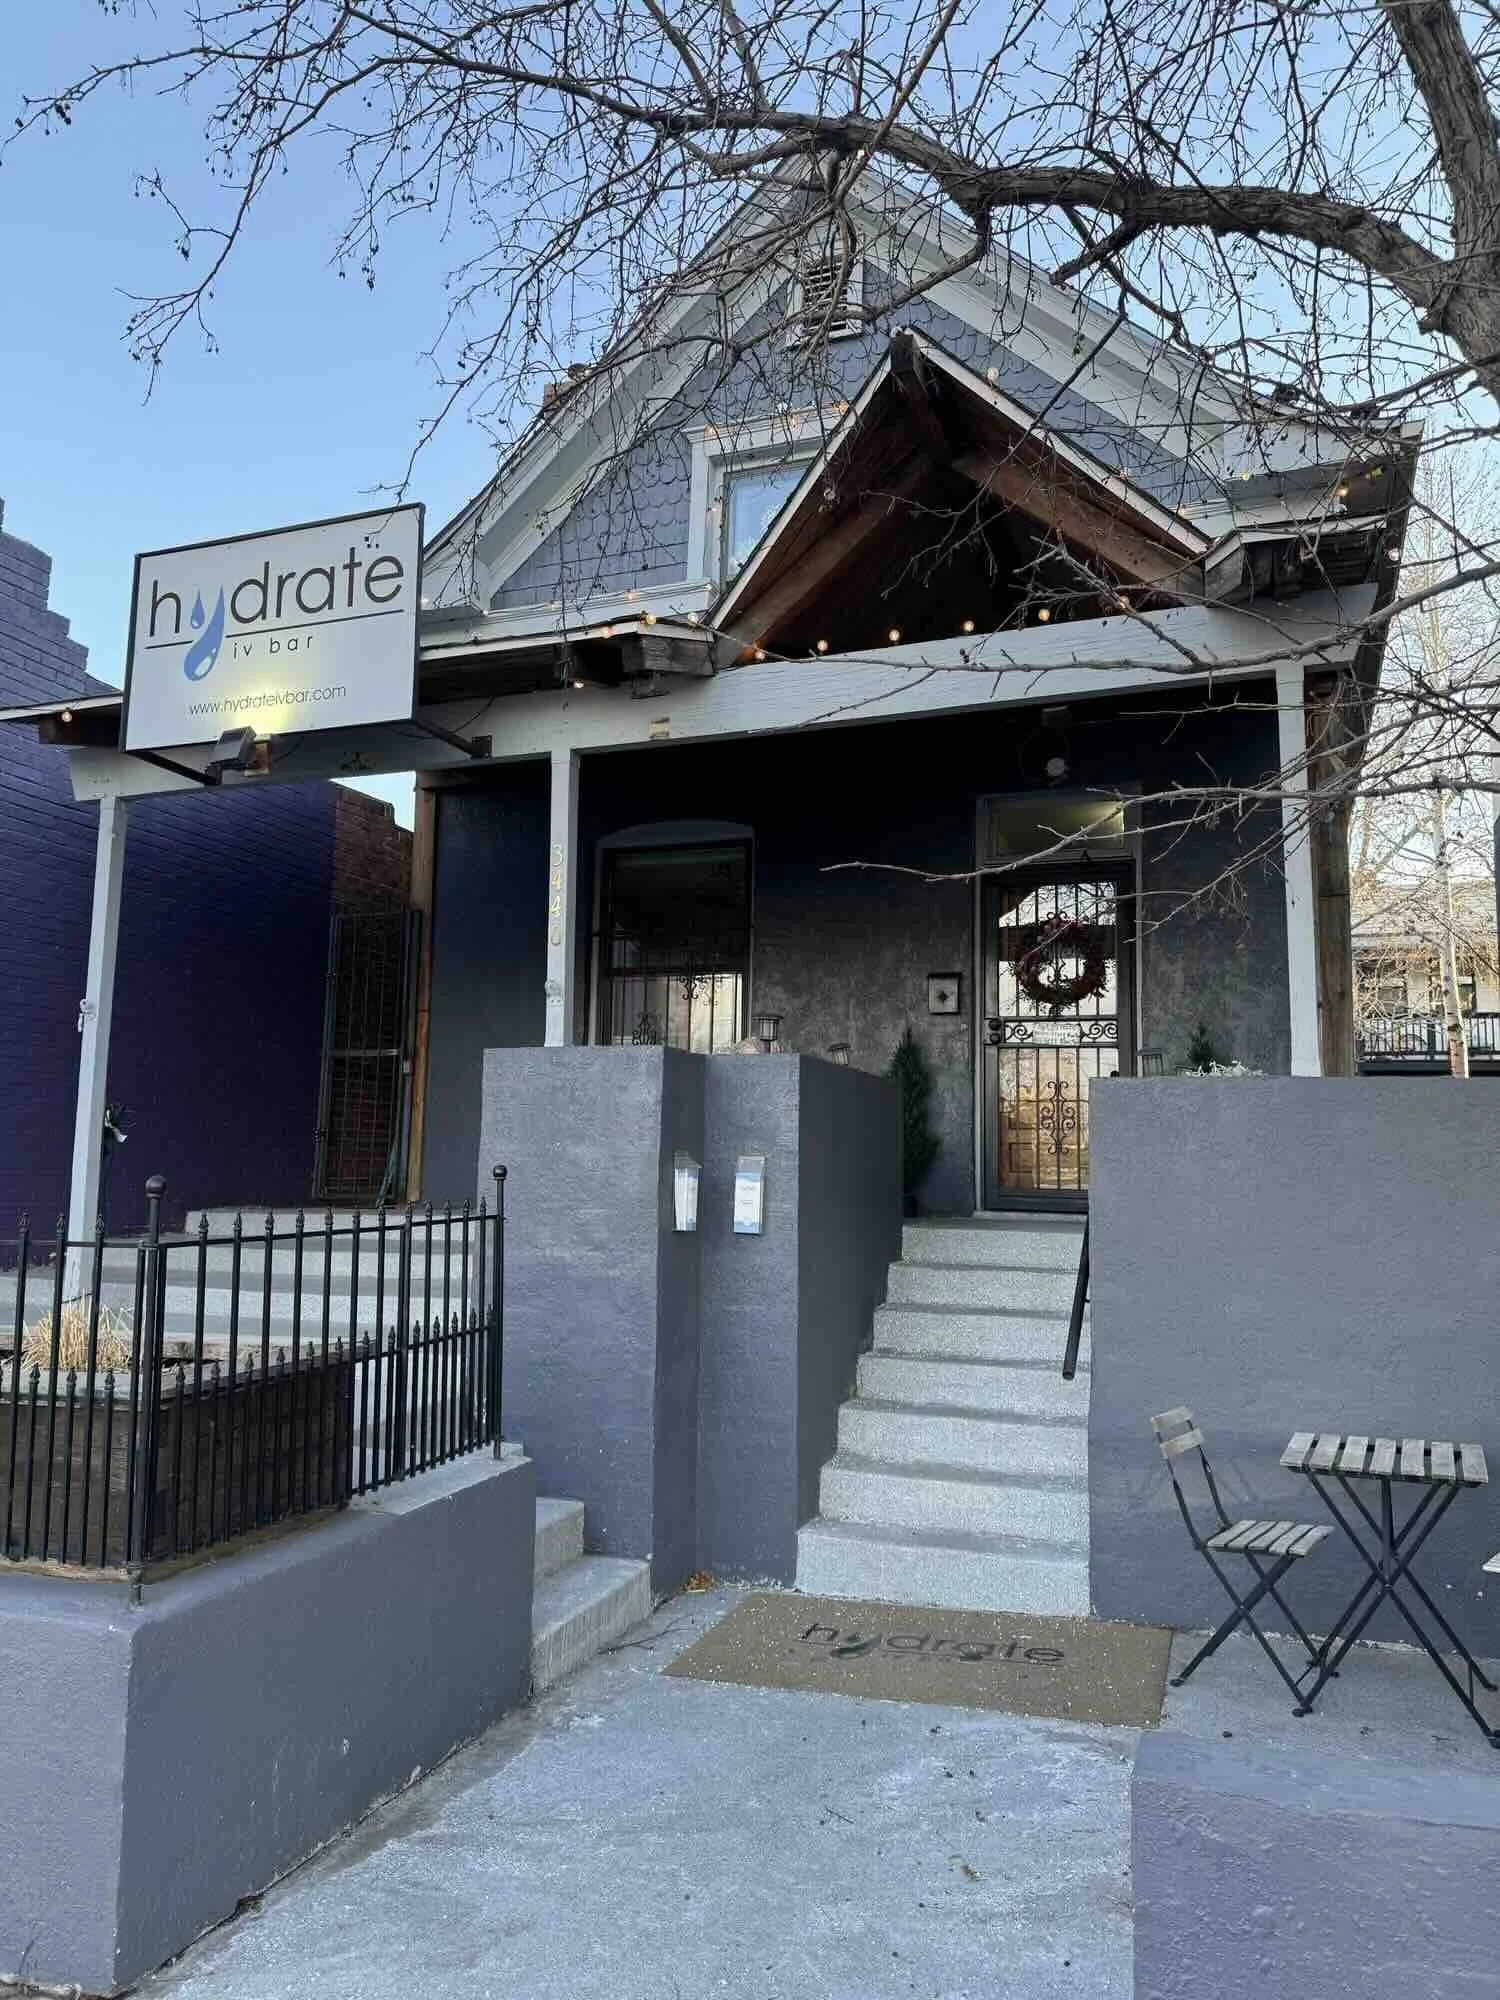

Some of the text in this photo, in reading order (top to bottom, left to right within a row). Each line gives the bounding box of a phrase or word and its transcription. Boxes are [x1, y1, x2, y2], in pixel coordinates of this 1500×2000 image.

[149, 547, 404, 681] hydrate
[233, 635, 313, 659] iv bar
[189, 685, 346, 715] www.hydrateivbar.com
